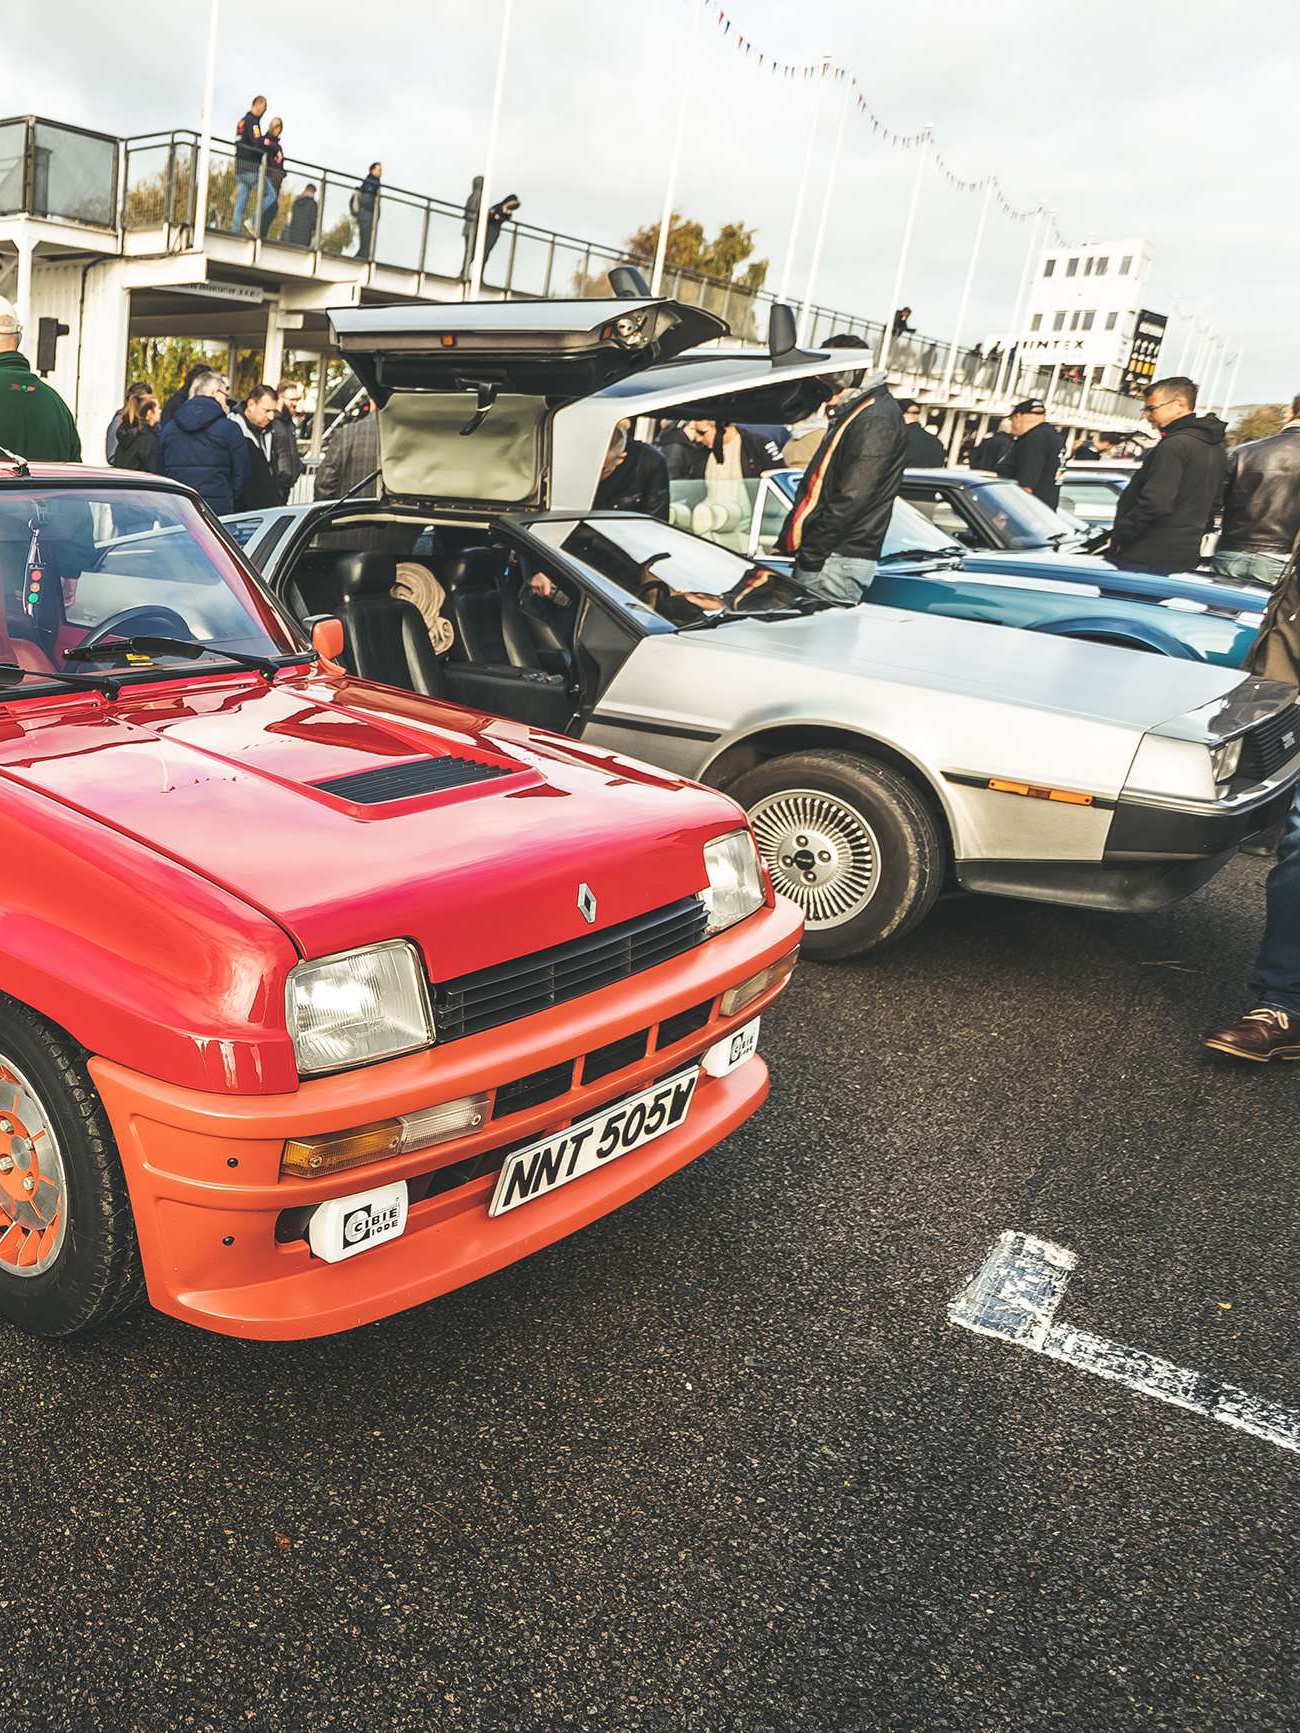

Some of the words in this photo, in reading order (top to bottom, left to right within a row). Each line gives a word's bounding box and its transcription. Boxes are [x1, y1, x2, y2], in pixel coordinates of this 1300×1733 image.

[503, 1127, 594, 1207] NNT
[596, 1077, 696, 1159] 505W
[354, 1208, 397, 1232] CIBIE
[371, 1219, 398, 1236] IODE
